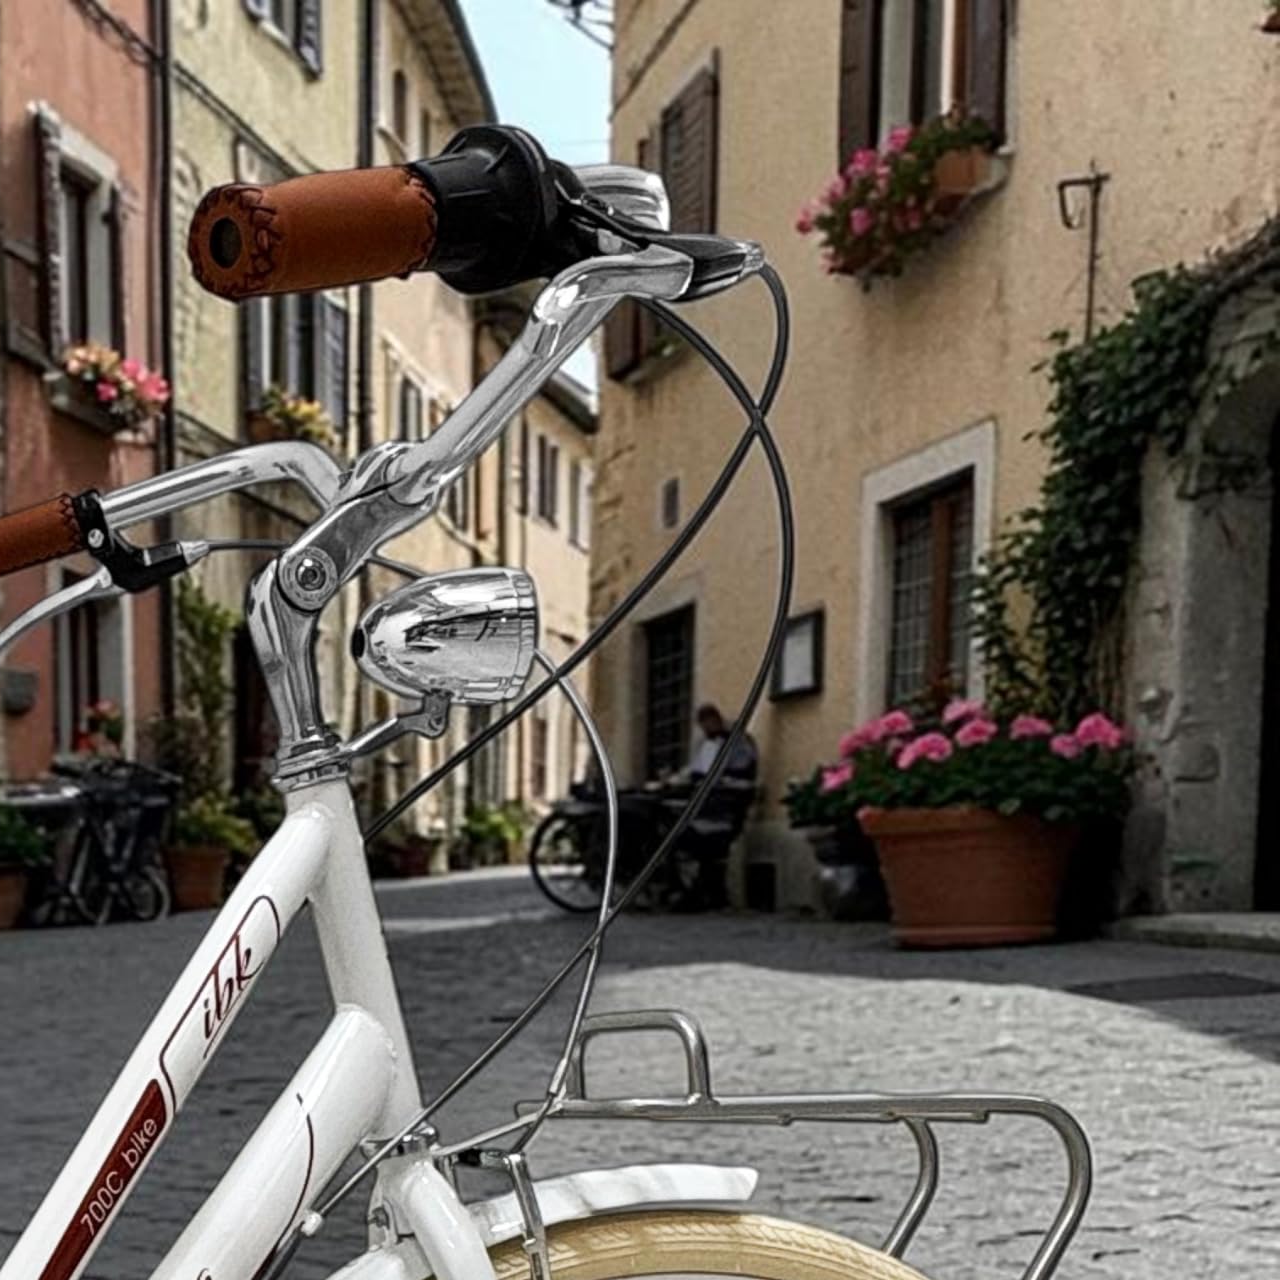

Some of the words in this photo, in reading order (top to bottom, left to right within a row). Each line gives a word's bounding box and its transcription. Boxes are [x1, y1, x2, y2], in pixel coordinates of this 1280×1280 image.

[203, 933, 266, 1059] ibk
[80, 1170, 124, 1237] 700C
[120, 1118, 157, 1169] bike
